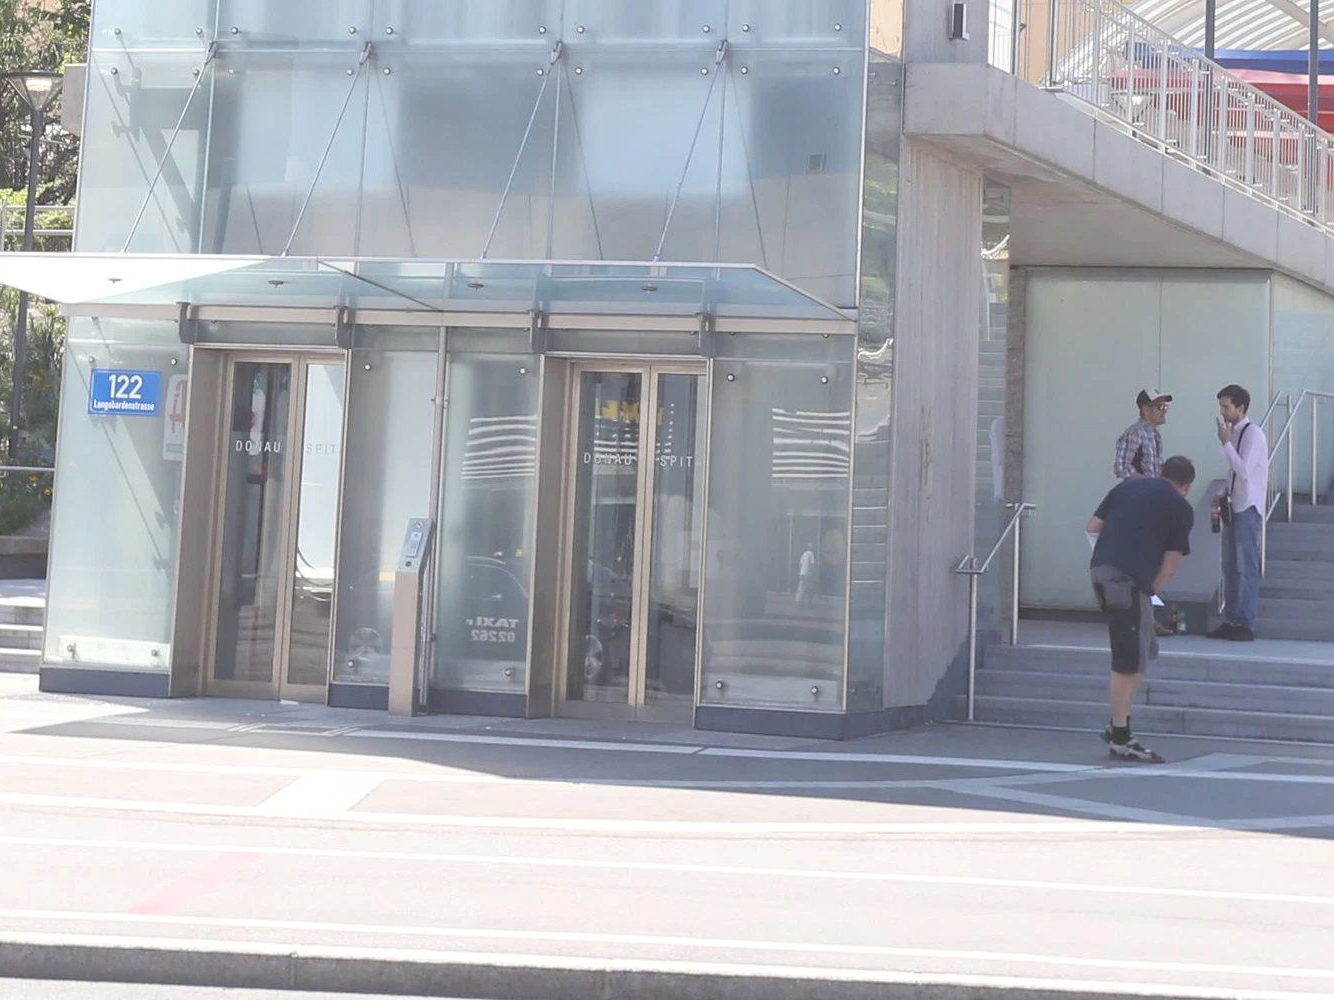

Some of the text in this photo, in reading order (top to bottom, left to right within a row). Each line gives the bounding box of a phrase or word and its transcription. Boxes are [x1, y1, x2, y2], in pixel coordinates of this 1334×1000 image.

[108, 374, 144, 399] 122
[93, 399, 155, 411] Langobardenstrasse
[235, 440, 281, 453] DONAU
